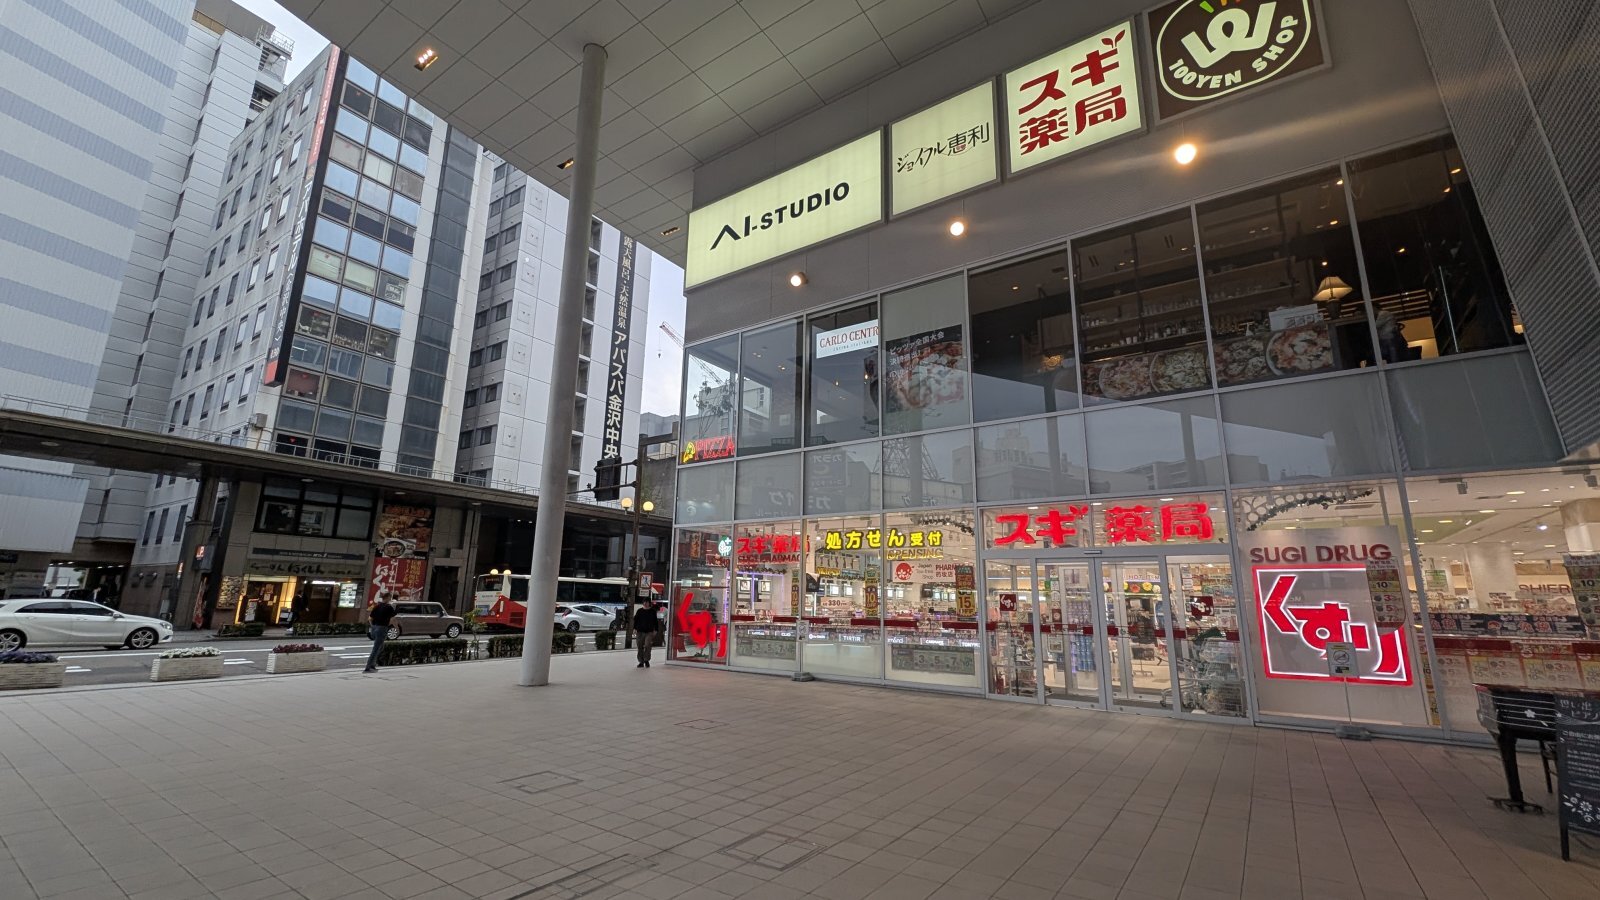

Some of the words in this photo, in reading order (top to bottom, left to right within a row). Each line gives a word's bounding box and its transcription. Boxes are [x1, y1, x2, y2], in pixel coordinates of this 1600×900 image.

[1018, 29, 1126, 115] スギ
[1168, 58, 1242, 89] 100YEN
[1251, 15, 1299, 73] SHOP
[1018, 85, 1128, 156] 薬局
[897, 121, 990, 173] ジョイフル恵利
[819, 333, 848, 348] CARLO
[603, 330, 628, 460] アパスパ金沢中央
[826, 529, 943, 550] 処方せん受付
[995, 502, 1214, 546] スギ薬局
[1250, 546, 1308, 564] SUGI
[1315, 543, 1392, 562] DRUG
[958, 597, 972, 609] 15
[1263, 574, 1402, 674] くすり
